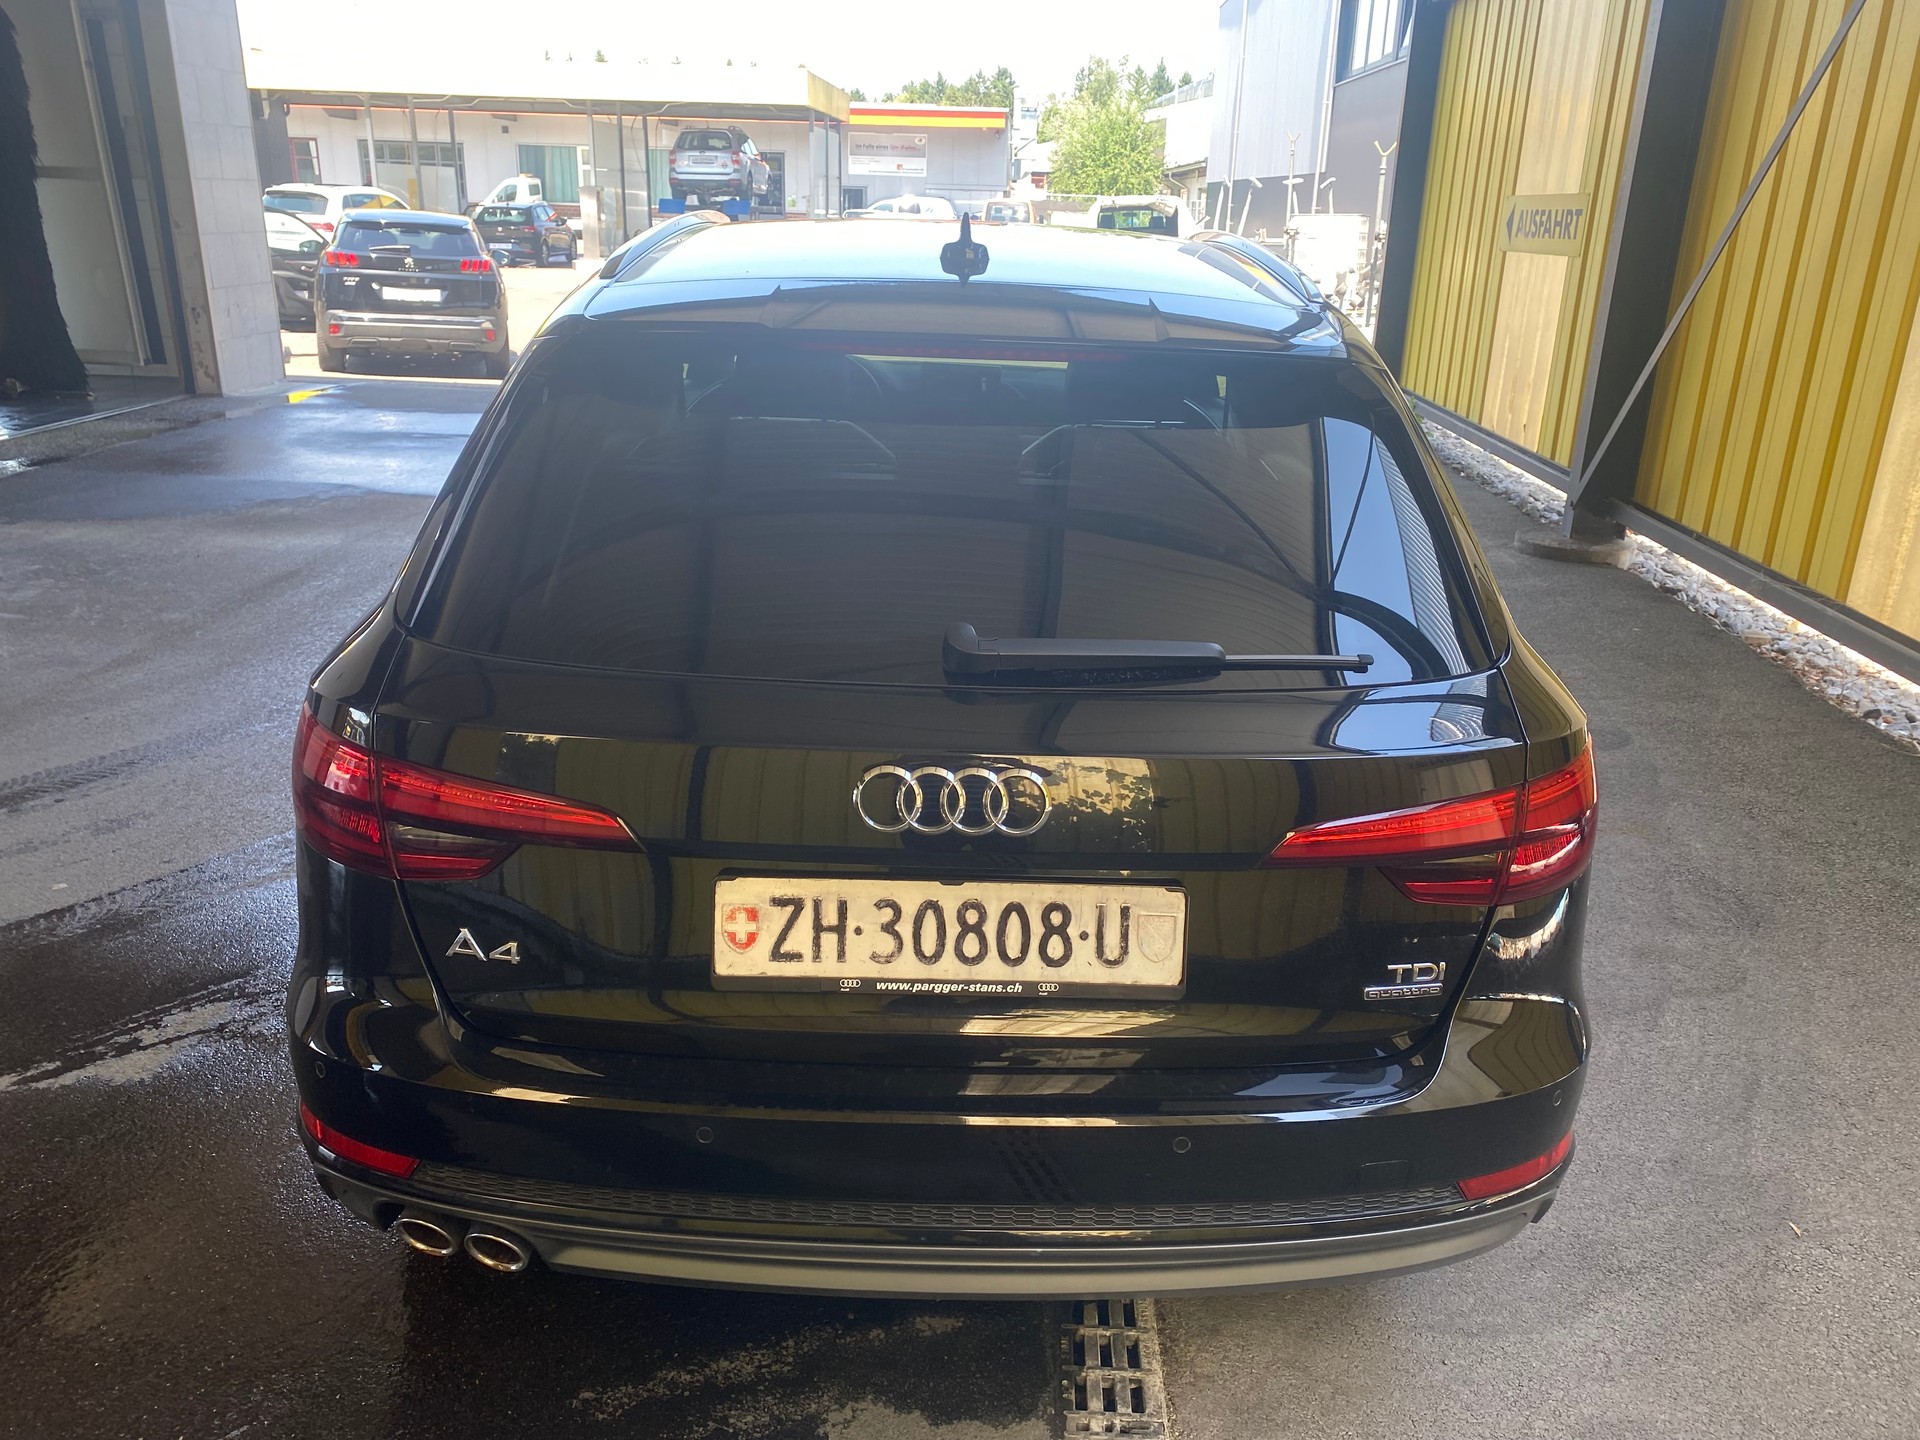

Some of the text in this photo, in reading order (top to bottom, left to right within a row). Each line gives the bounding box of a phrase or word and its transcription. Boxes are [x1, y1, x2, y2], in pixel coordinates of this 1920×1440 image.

[1515, 208, 1583, 240] AUSFAHRT
[445, 927, 521, 965] A4
[1387, 961, 1446, 983] TDI
[876, 981, 1023, 994] www.pargger-stans.ch
[1368, 987, 1440, 999] quattro
